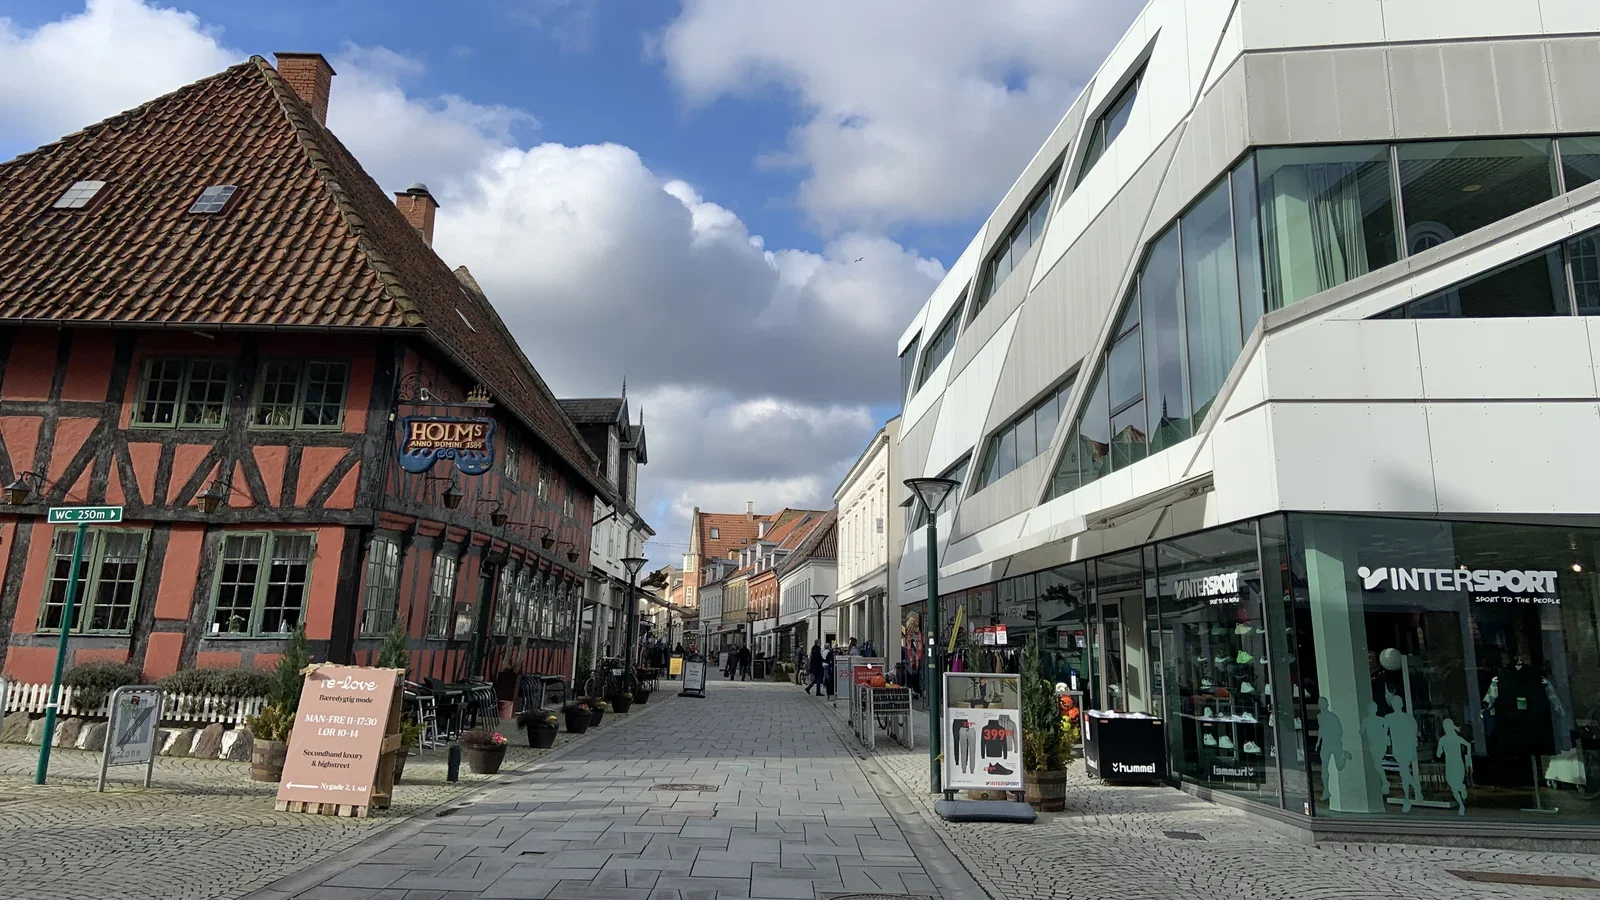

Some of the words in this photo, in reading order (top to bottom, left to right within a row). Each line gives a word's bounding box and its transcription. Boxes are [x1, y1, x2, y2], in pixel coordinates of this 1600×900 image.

[411, 423, 482, 441] HOLMS
[408, 440, 432, 448] ANNO
[434, 440, 462, 448] DOMINI
[55, 510, 72, 520] WC
[78, 509, 105, 519] 250m
[1184, 572, 1238, 598] INTERSPORT
[1390, 567, 1558, 593] INTERSPORT
[1514, 596, 1530, 604] THE
[1533, 597, 1561, 605] PEOPLE
[320, 675, 379, 691] re-love
[319, 694, 355, 704] Bæredygtig
[304, 713, 346, 725] MAN-FRE
[317, 727, 336, 737] LØR
[337, 728, 359, 738] 10-14
[983, 728, 1006, 741] 399
[120, 748, 141, 758] Zone
[303, 749, 342, 758] Secondhand
[342, 751, 363, 761] luxury
[317, 760, 351, 769] highstreet
[1119, 762, 1156, 773] hummel
[320, 782, 345, 791] Nygade
